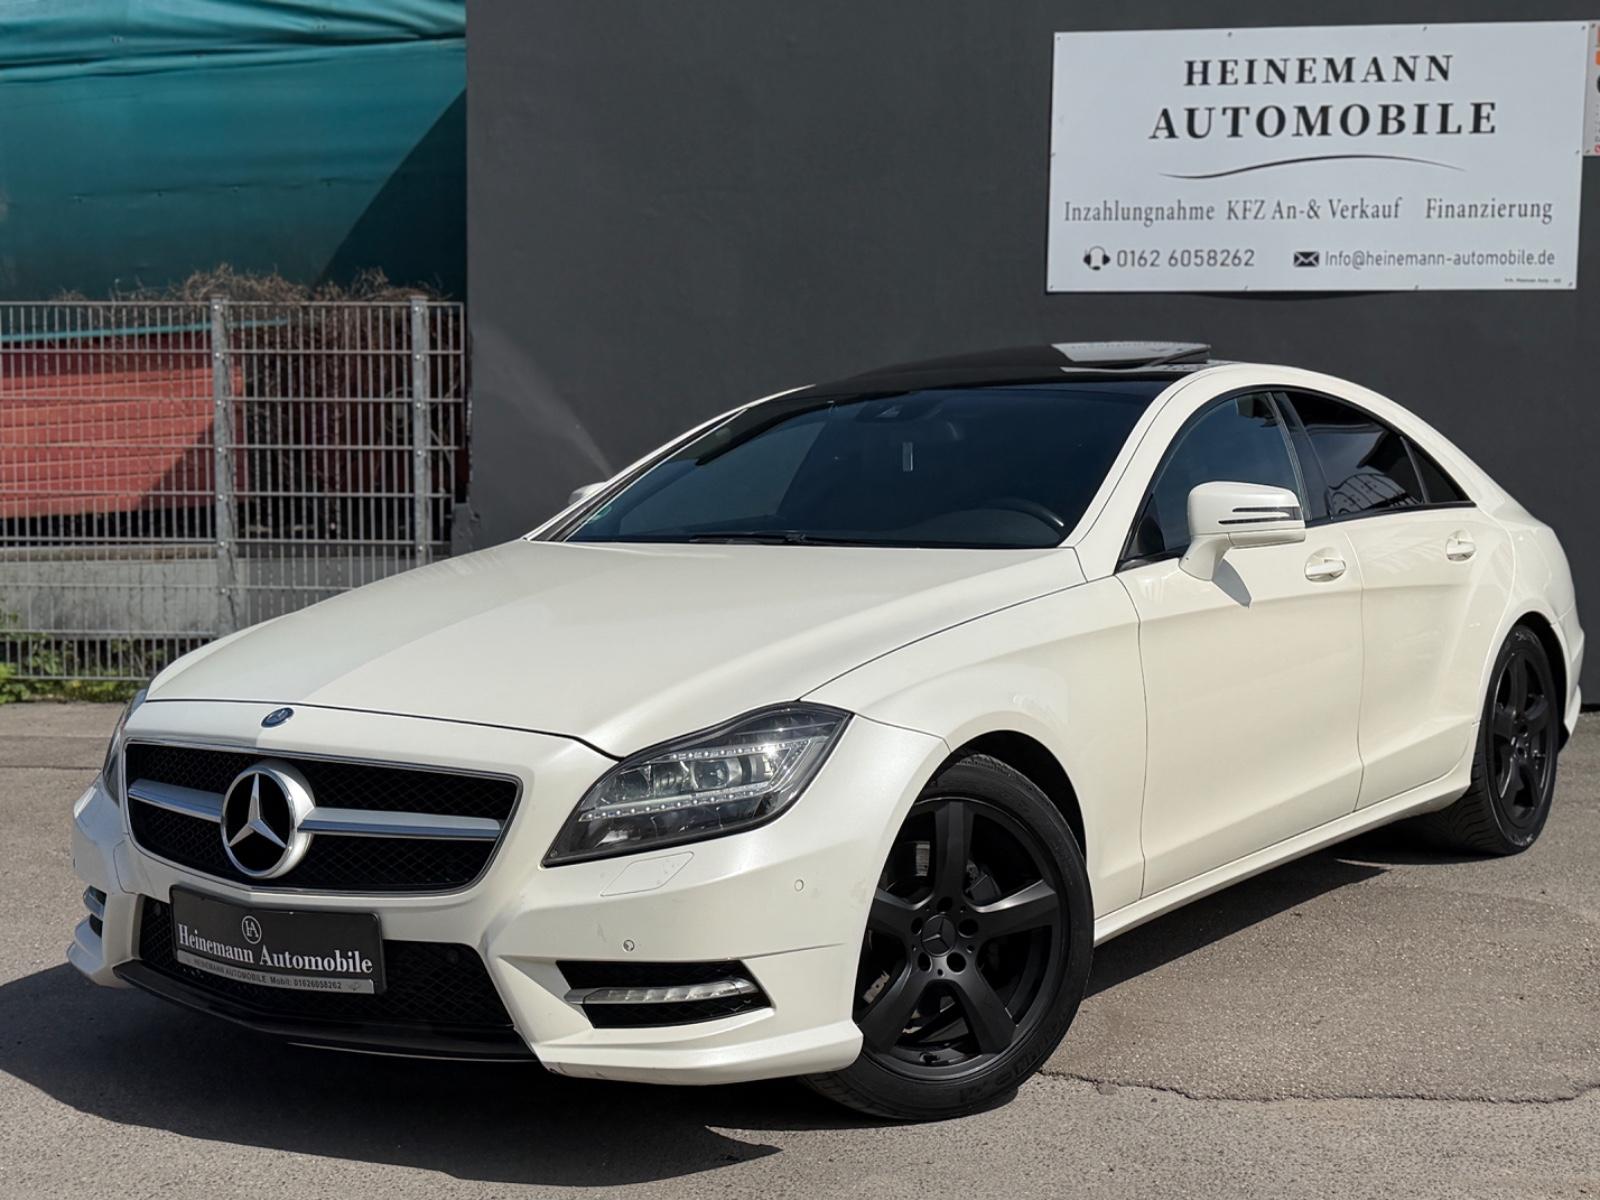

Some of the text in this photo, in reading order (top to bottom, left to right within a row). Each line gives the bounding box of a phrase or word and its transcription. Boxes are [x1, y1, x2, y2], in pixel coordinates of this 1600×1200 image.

[1183, 55, 1454, 86] HEINEMANN
[1149, 101, 1497, 140] AUTOMOBILE
[1064, 198, 1215, 227] Inzahlungnahme
[1226, 199, 1266, 220] KFZ
[1328, 197, 1402, 219] Verkauf
[1425, 198, 1553, 225] Finanzierung
[1116, 249, 1256, 267] 0162 6058262
[1325, 250, 1556, 270] Info@heinemann-automobile.de
[178, 923, 373, 973] Heinemann Automobile
